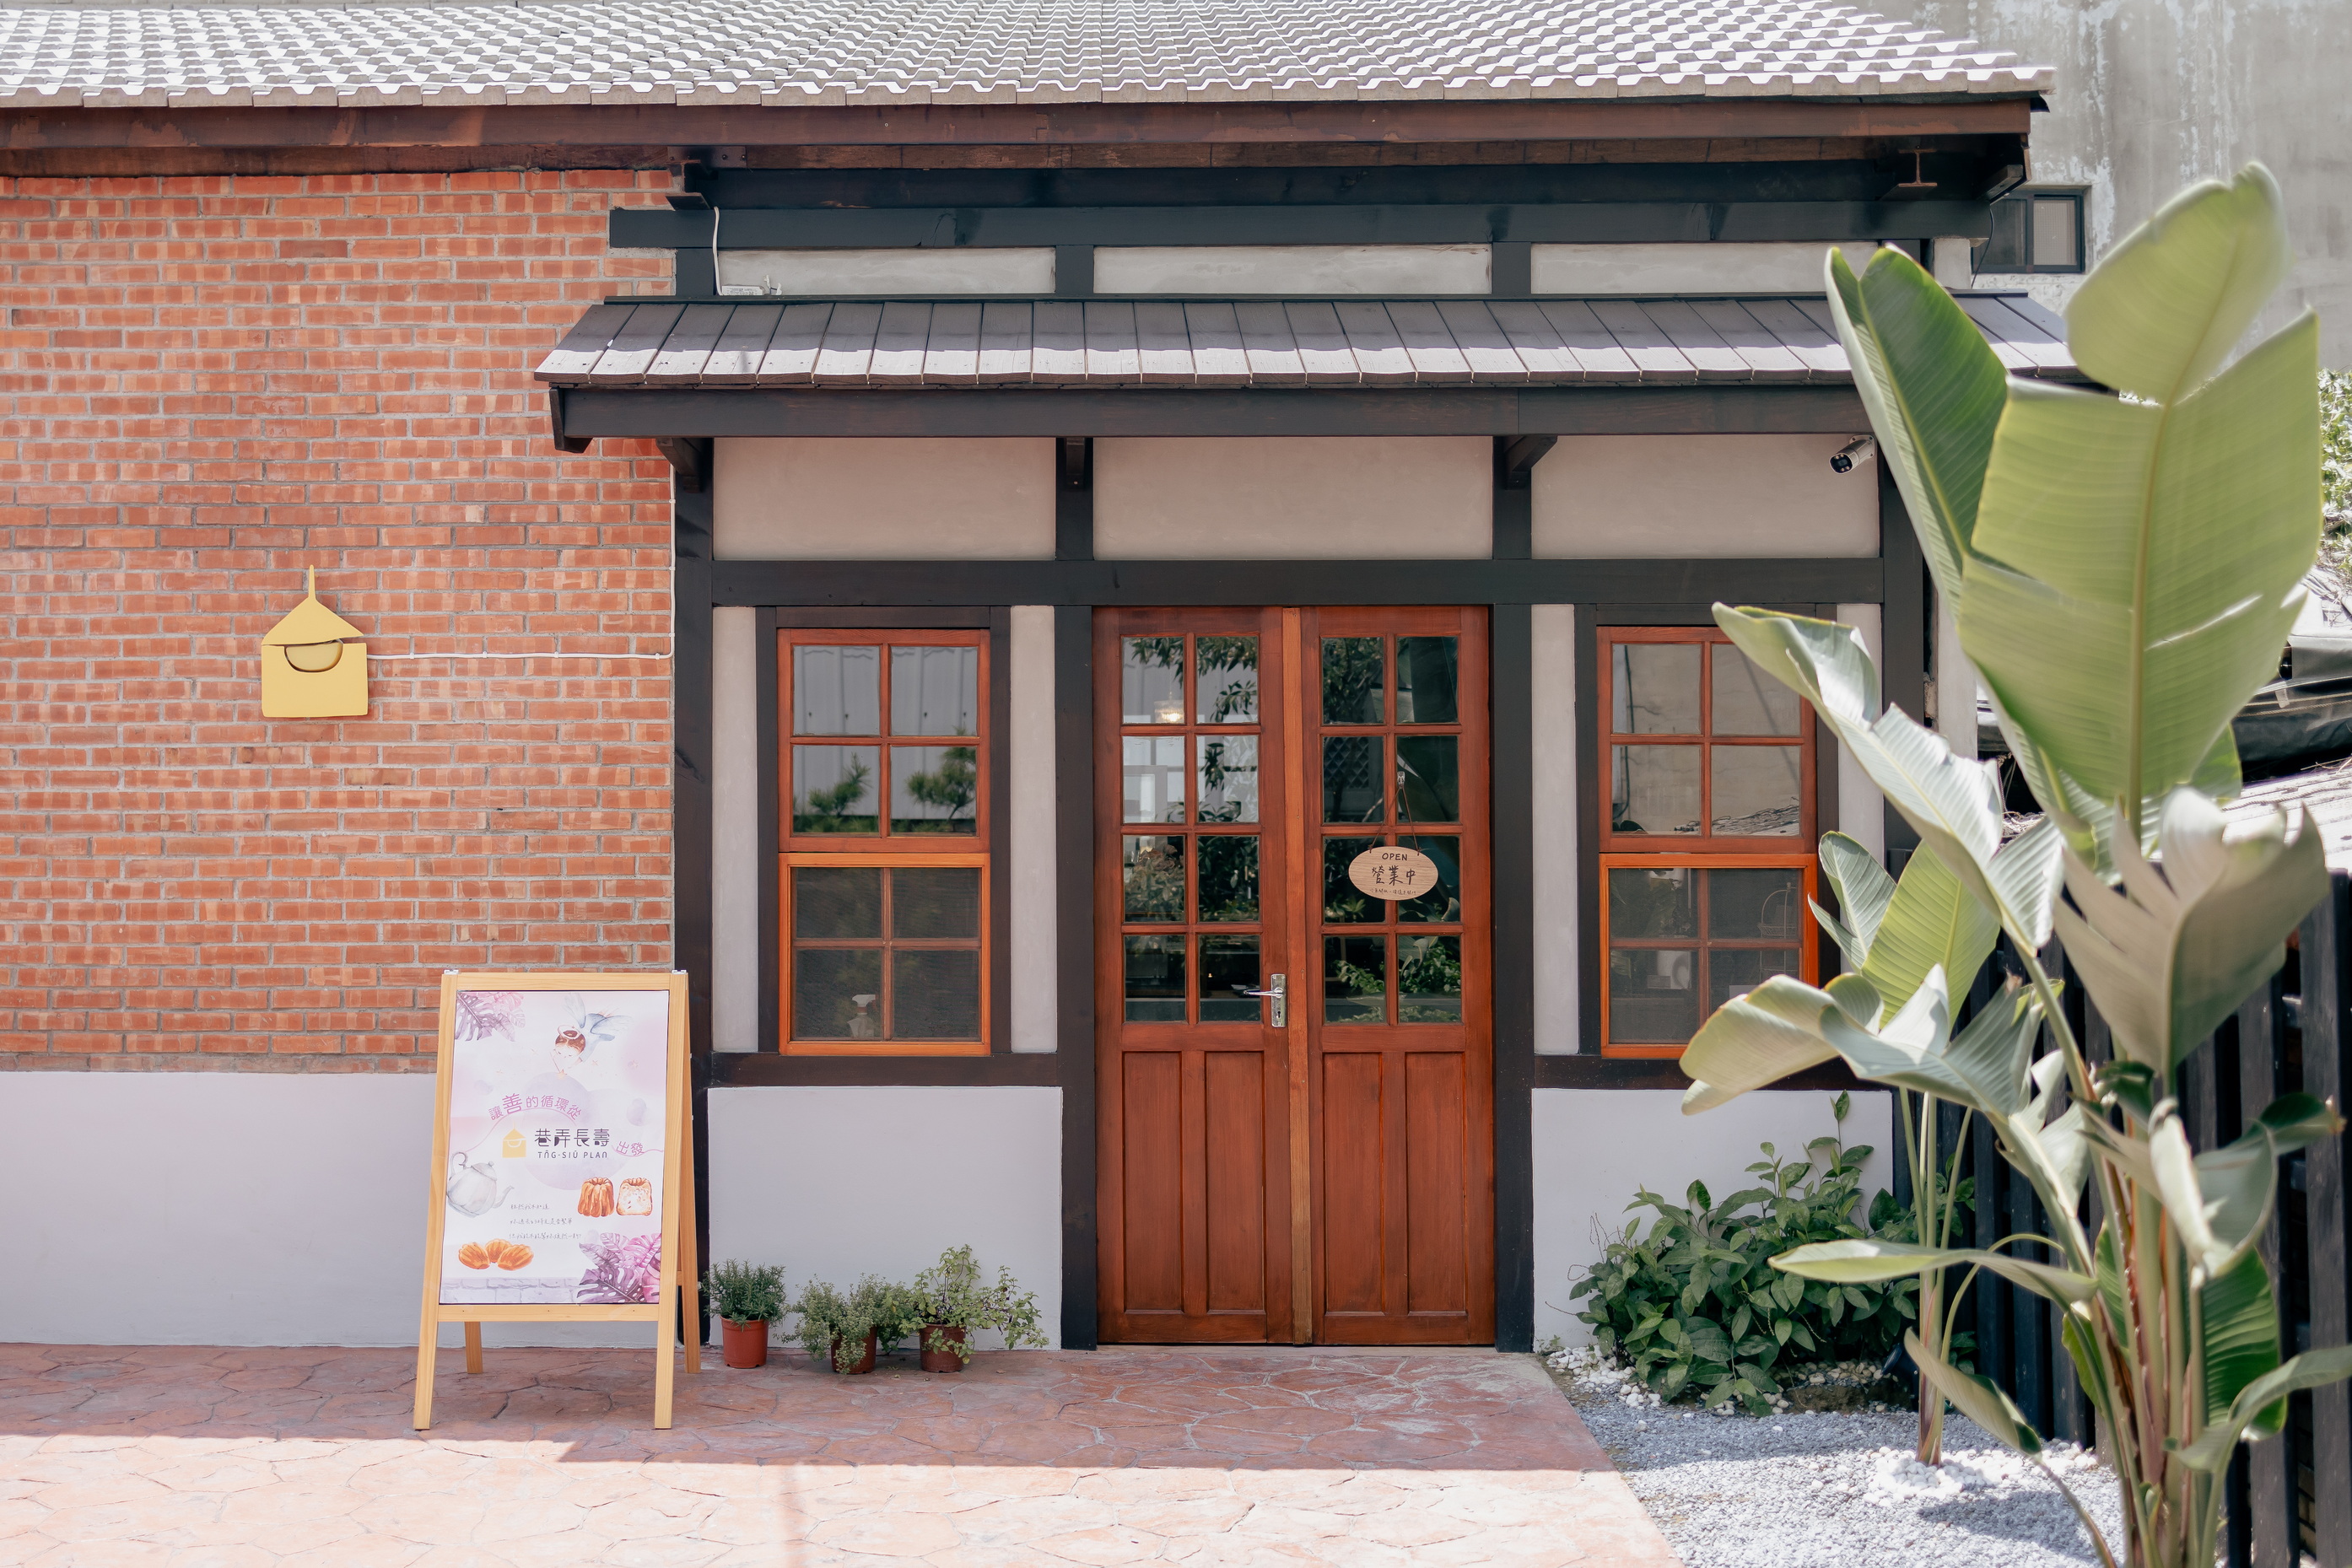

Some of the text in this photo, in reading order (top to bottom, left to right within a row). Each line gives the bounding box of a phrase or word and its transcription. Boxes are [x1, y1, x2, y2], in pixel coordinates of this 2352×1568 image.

[1382, 852, 1408, 860] OPEN
[1371, 865, 1416, 886] 營業中
[488, 1093, 582, 1121] 讓善的循環從
[534, 1129, 610, 1148] 巷弄長壽
[616, 1140, 645, 1156] 出發
